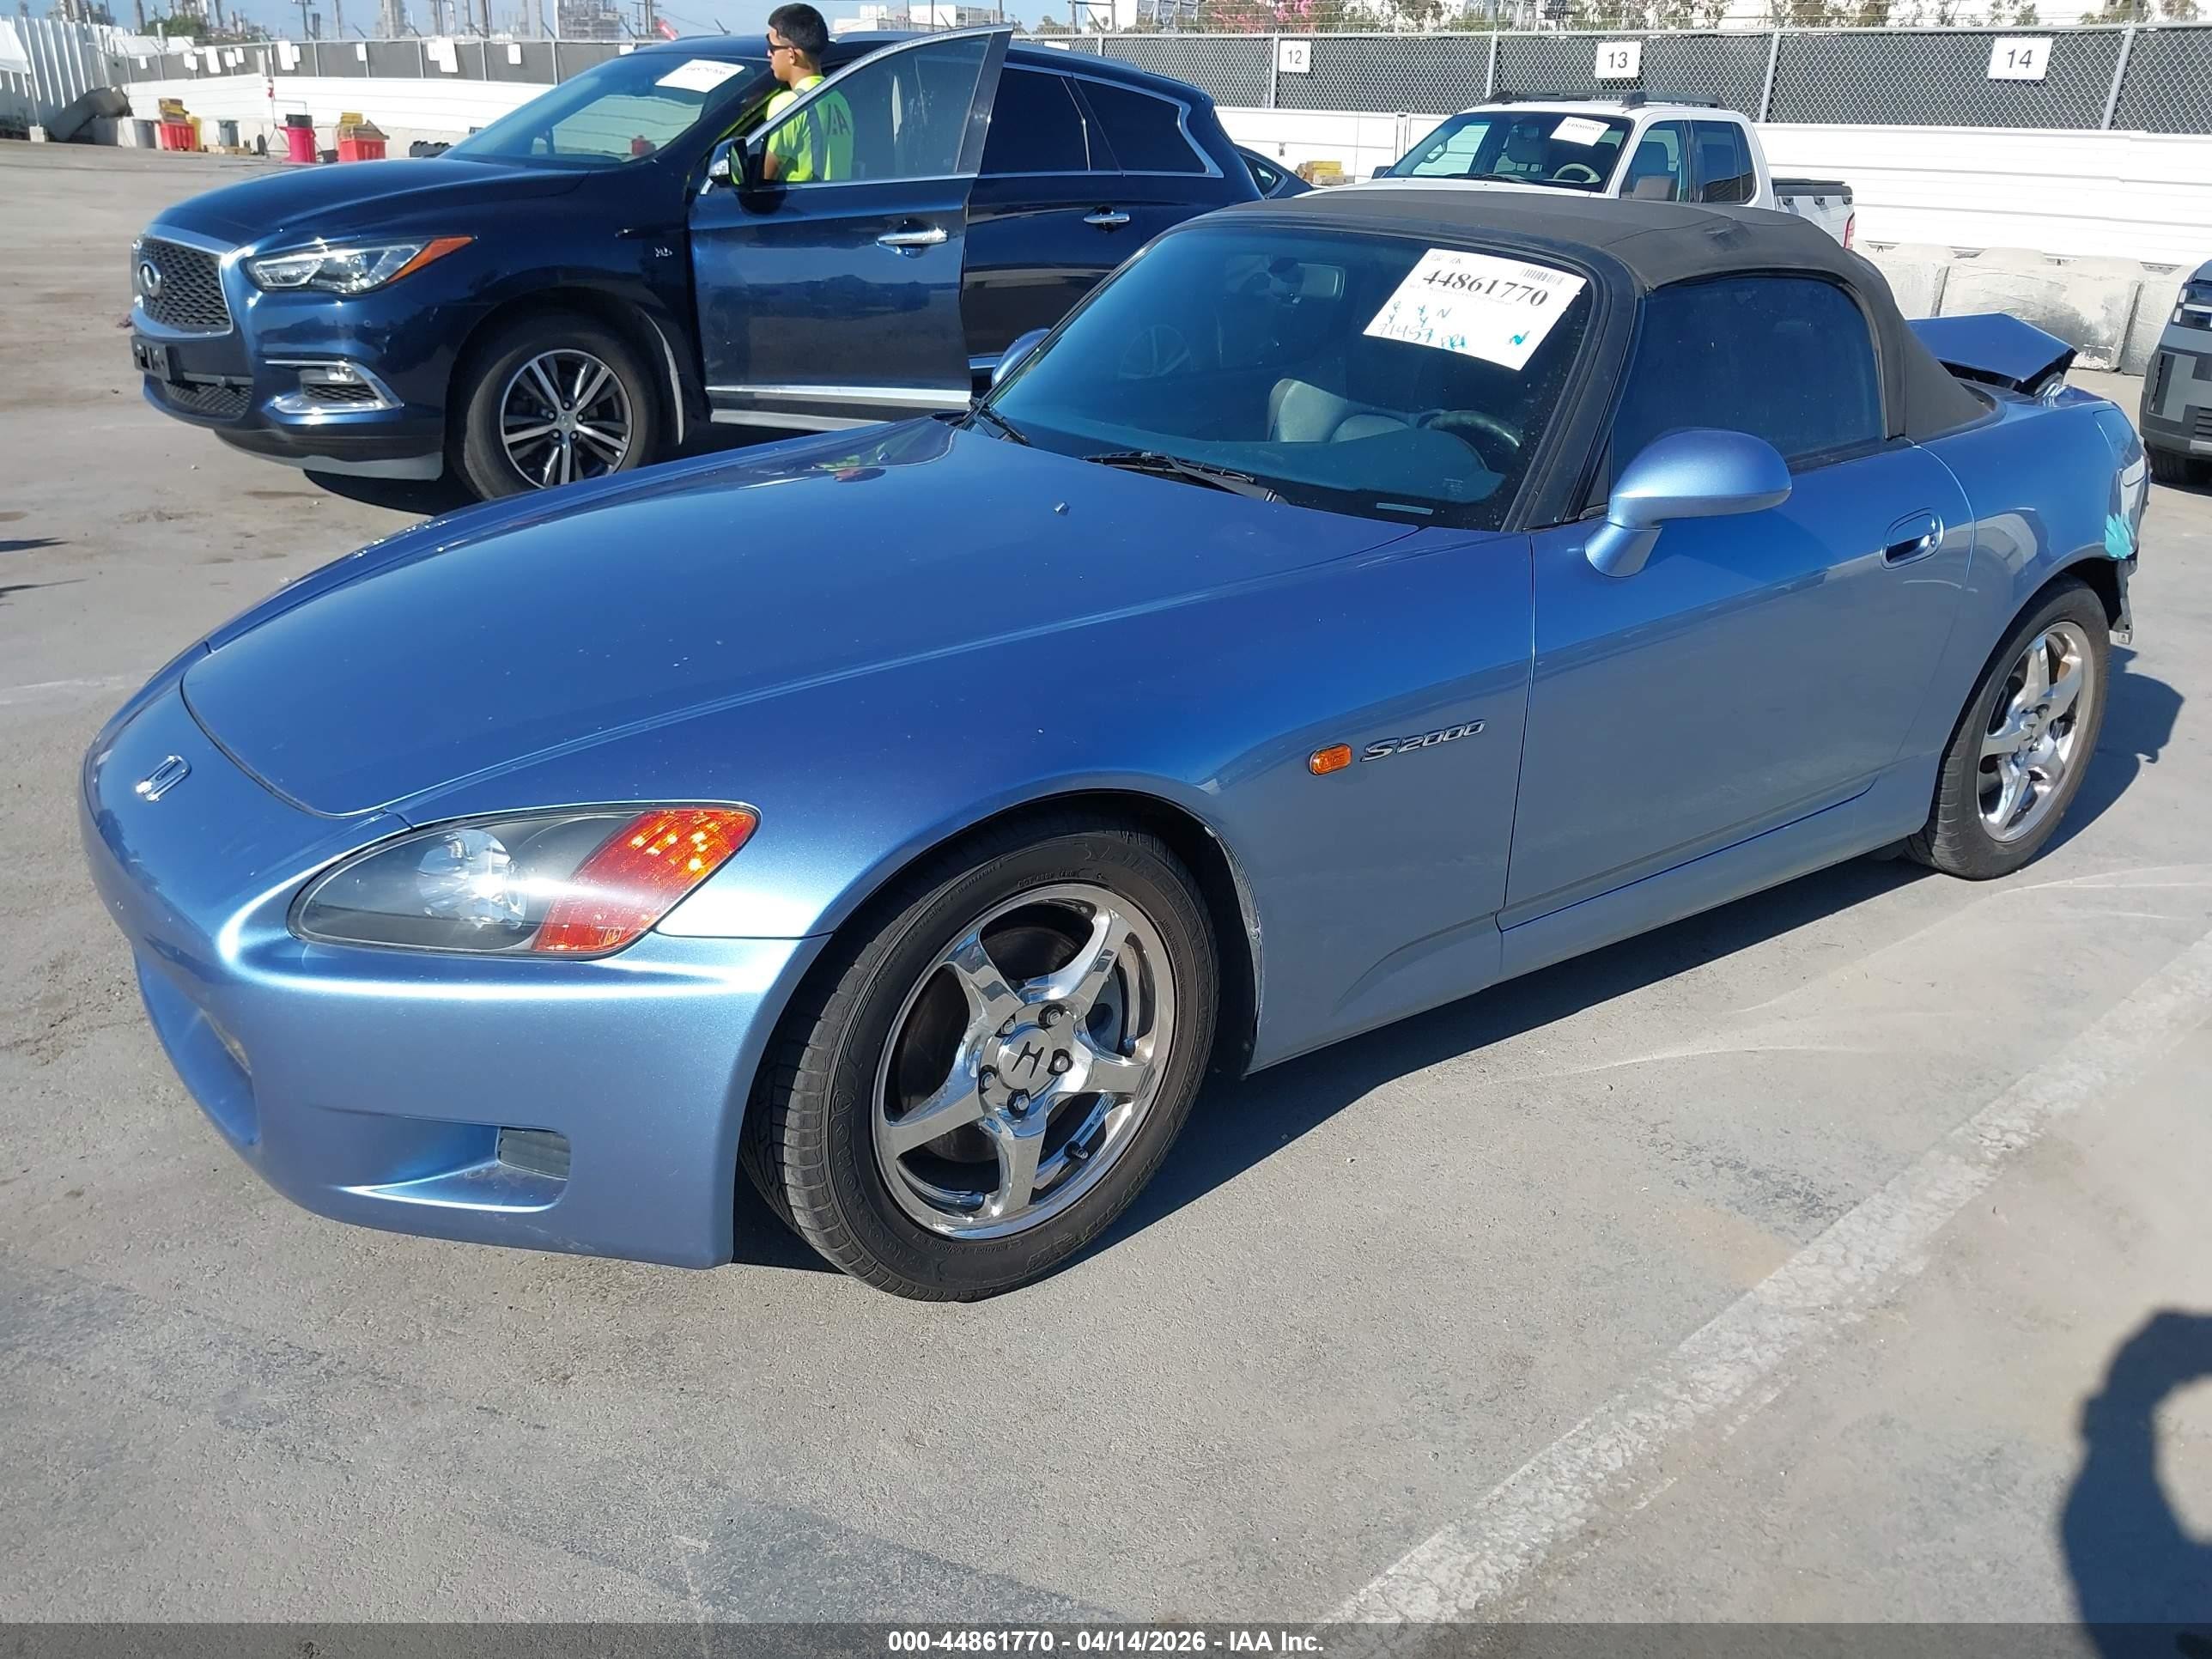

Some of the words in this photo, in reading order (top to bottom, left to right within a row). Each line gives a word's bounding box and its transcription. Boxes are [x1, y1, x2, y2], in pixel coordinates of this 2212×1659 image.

[1288, 50, 1302, 64] 12
[1608, 52, 1628, 69] 13
[2008, 49, 2033, 69] 14
[1423, 269, 1549, 307] 44861770
[1360, 718, 1487, 763] S2000
